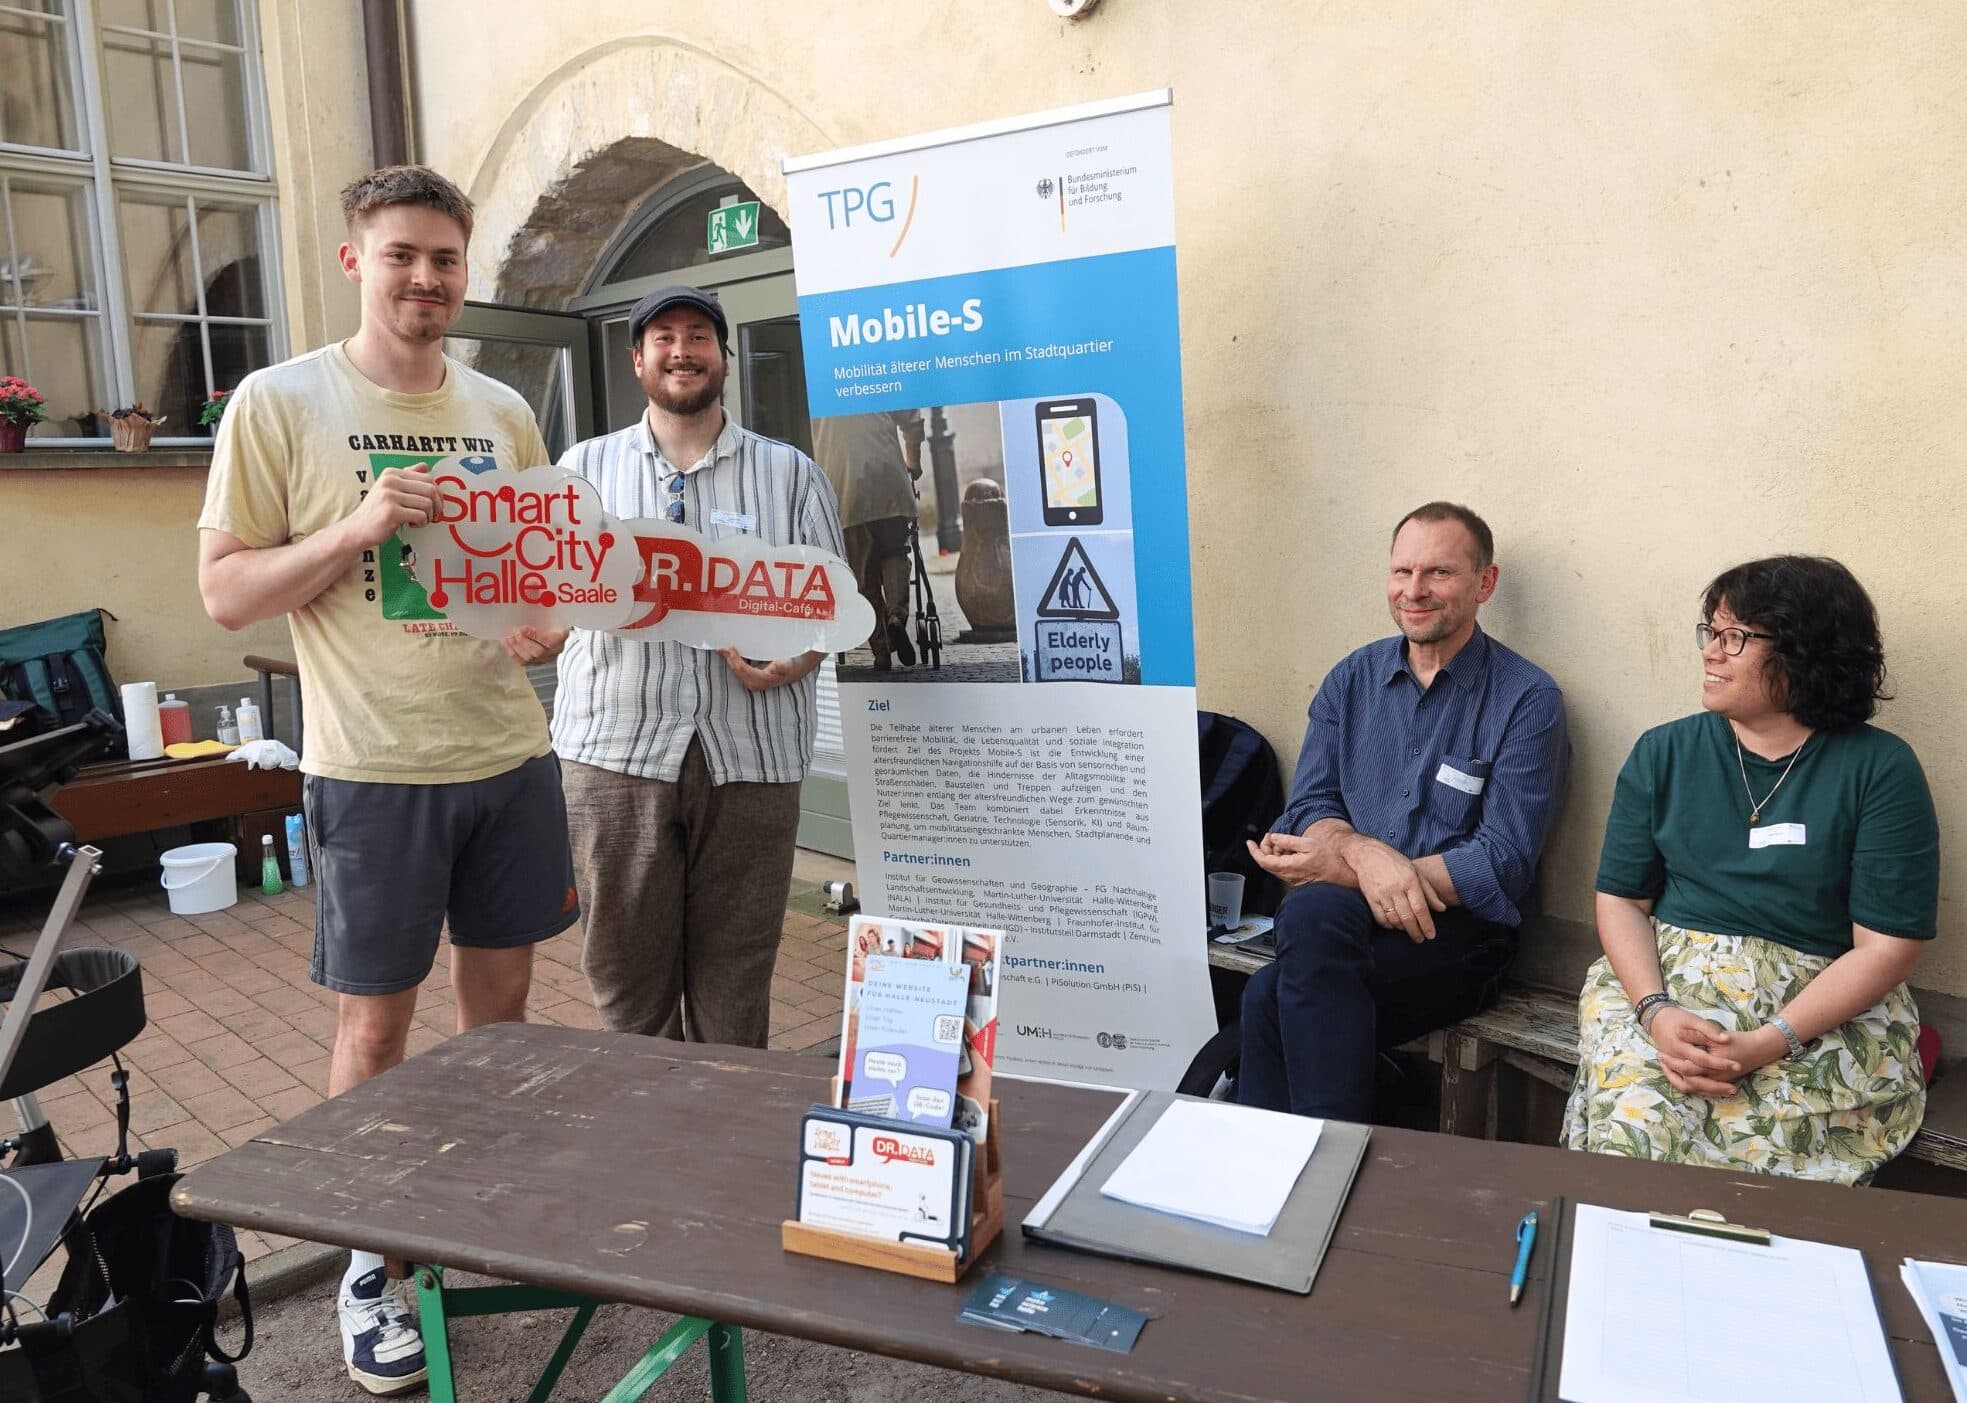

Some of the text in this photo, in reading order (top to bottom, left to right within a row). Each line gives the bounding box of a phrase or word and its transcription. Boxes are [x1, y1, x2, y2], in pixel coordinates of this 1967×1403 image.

[1068, 167, 1137, 184] Bundesministerium
[1068, 182, 1108, 196] für Bildung
[818, 181, 896, 230] TPG
[1069, 192, 1122, 206] und Forschung
[829, 298, 984, 348] Mobile-S
[834, 338, 1114, 381] Mobilität älterer Menschen im Stadtquartier
[836, 380, 902, 397] verbessern
[348, 434, 494, 453] CARHARTT WIP
[433, 476, 581, 524] Smart
[516, 526, 615, 583] City
[431, 559, 618, 609] Halle Saale
[738, 598, 812, 618] Digital-Café
[402, 622, 436, 633] LATE
[1047, 631, 1110, 652] Elderly
[1050, 655, 1113, 673] people
[868, 700, 890, 711] Ziel
[871, 723, 1144, 738] Die Teilhabe älterer Menschen am urbanen Leben erfordert
[871, 735, 917, 743] barrierefreie
[922, 736, 958, 745] Mobilität,
[963, 736, 976, 744] die
[982, 737, 1039, 747] Lebensqualität
[1103, 739, 1144, 750] Integration
[907, 746, 921, 754] Ziel
[928, 746, 941, 755] des
[949, 747, 980, 757] Projekts
[988, 748, 1022, 756] Mobile-S
[1030, 749, 1040, 757] ist
[1048, 749, 1062, 757] die
[1071, 749, 1118, 761] Entwicklung
[1125, 754, 1144, 762] einer
[873, 756, 940, 766] altersfreundlichen
[942, 758, 1003, 768] Navigationshilfe
[1005, 760, 1018, 768] auf
[1020, 760, 1033, 768] der
[1036, 760, 1057, 768] Basis
[1078, 761, 1128, 772] sensorischen
[1130, 766, 1145, 774] und
[874, 767, 1147, 786] georäumlichen Daten, die Hindernisse der Alltagsmobilität wie
[875, 778, 937, 788] Straßenschäden,
[945, 780, 985, 789] Baustellen
[1017, 783, 1051, 792] Treppen
[1061, 783, 1101, 793] aufzeigen
[1111, 786, 1125, 794] und
[1133, 789, 1148, 797] den
[877, 789, 923, 798] Nutzer:innen
[927, 791, 955, 801] entlang
[958, 792, 971, 800] der
[974, 793, 1046, 803] altersfreundlichen
[1050, 796, 1073, 805] Wege
[1099, 797, 1148, 809] gewünschten
[878, 799, 890, 808] Ziel
[900, 801, 920, 809] lenkt.
[930, 802, 944, 810] Das
[954, 803, 976, 811] Team
[986, 805, 1029, 814] kombiniert
[1040, 806, 1063, 815] dabei
[1075, 806, 1126, 817] Erkenntnisse
[879, 810, 949, 821] Pflegewissenschaft,
[954, 813, 989, 823] Geriatrie,
[994, 815, 1040, 827] Technologie
[1045, 818, 1086, 828] (Sensorik,
[1091, 818, 1103, 828] KI)
[1107, 820, 1122, 828] und
[880, 822, 911, 831] planung,
[930, 824, 1025, 836] mobilitätseingeschränkte
[1028, 829, 1072, 838] Menschen,
[1075, 830, 1134, 841] Stadtplanende
[1136, 836, 1151, 845] und
[881, 832, 967, 844] Quartiermanager:innen
[980, 838, 1031, 848] unterstützen.
[883, 851, 971, 867] Partner:innen
[886, 873, 910, 881] Institut
[932, 875, 1004, 888] Geowissenschaften
[1010, 882, 1025, 890] und
[1031, 882, 1078, 893] Geographie
[1095, 885, 1107, 893] FG
[1113, 886, 1157, 901] Nachhaltige
[886, 884, 1158, 913] Landschaftsentwicklung, Martin-Luther-Universität Halle-Wittenberg
[925, 897, 952, 905] Institut
[956, 898, 967, 906] für
[973, 900, 1024, 911] Gesundheits-
[1028, 905, 1044, 913] und
[1049, 905, 1128, 917] Pflegewissenschaft
[888, 903, 980, 919] Martin-Luther-Universität
[986, 912, 1052, 925] Halle-Wittenberg
[1067, 918, 1144, 930] Fraunhofer-Institut
[1149, 924, 1160, 933] für
[1030, 926, 1074, 937] Institutsteil
[1075, 930, 1120, 939] Darmstadt
[1129, 932, 1161, 944] Zentrum
[1002, 955, 1105, 974] tpartner:innen
[1051, 978, 1091, 989] PiSolution
[1093, 983, 1120, 991] GmbH
[1122, 983, 1142, 992] (PiS)
